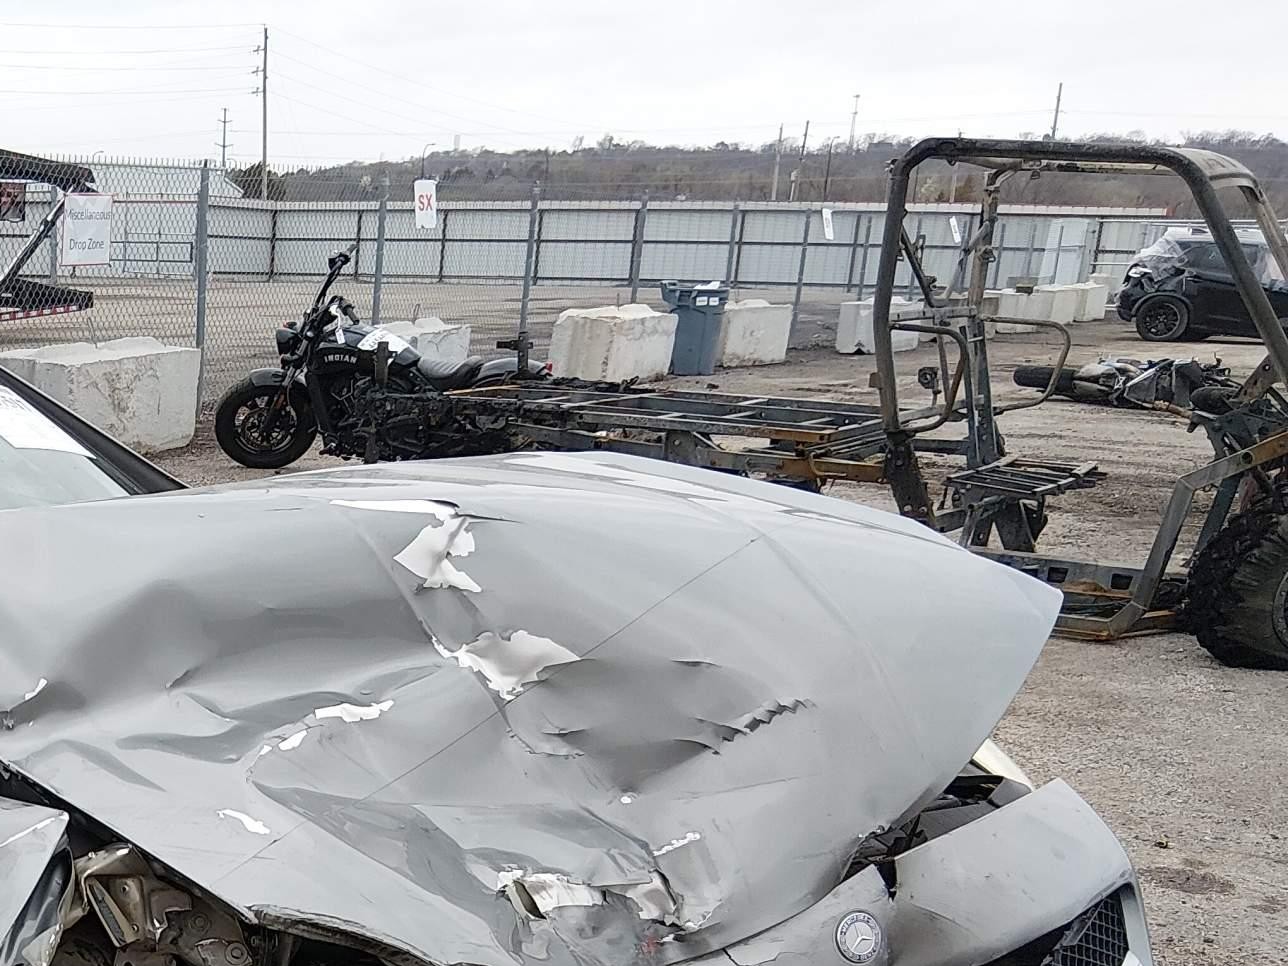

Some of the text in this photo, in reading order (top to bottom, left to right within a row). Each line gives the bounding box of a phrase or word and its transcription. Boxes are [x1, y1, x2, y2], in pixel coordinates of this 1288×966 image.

[418, 194, 432, 211] SX
[69, 238, 104, 250] Drop Zone
[324, 354, 358, 364] INDIAN
